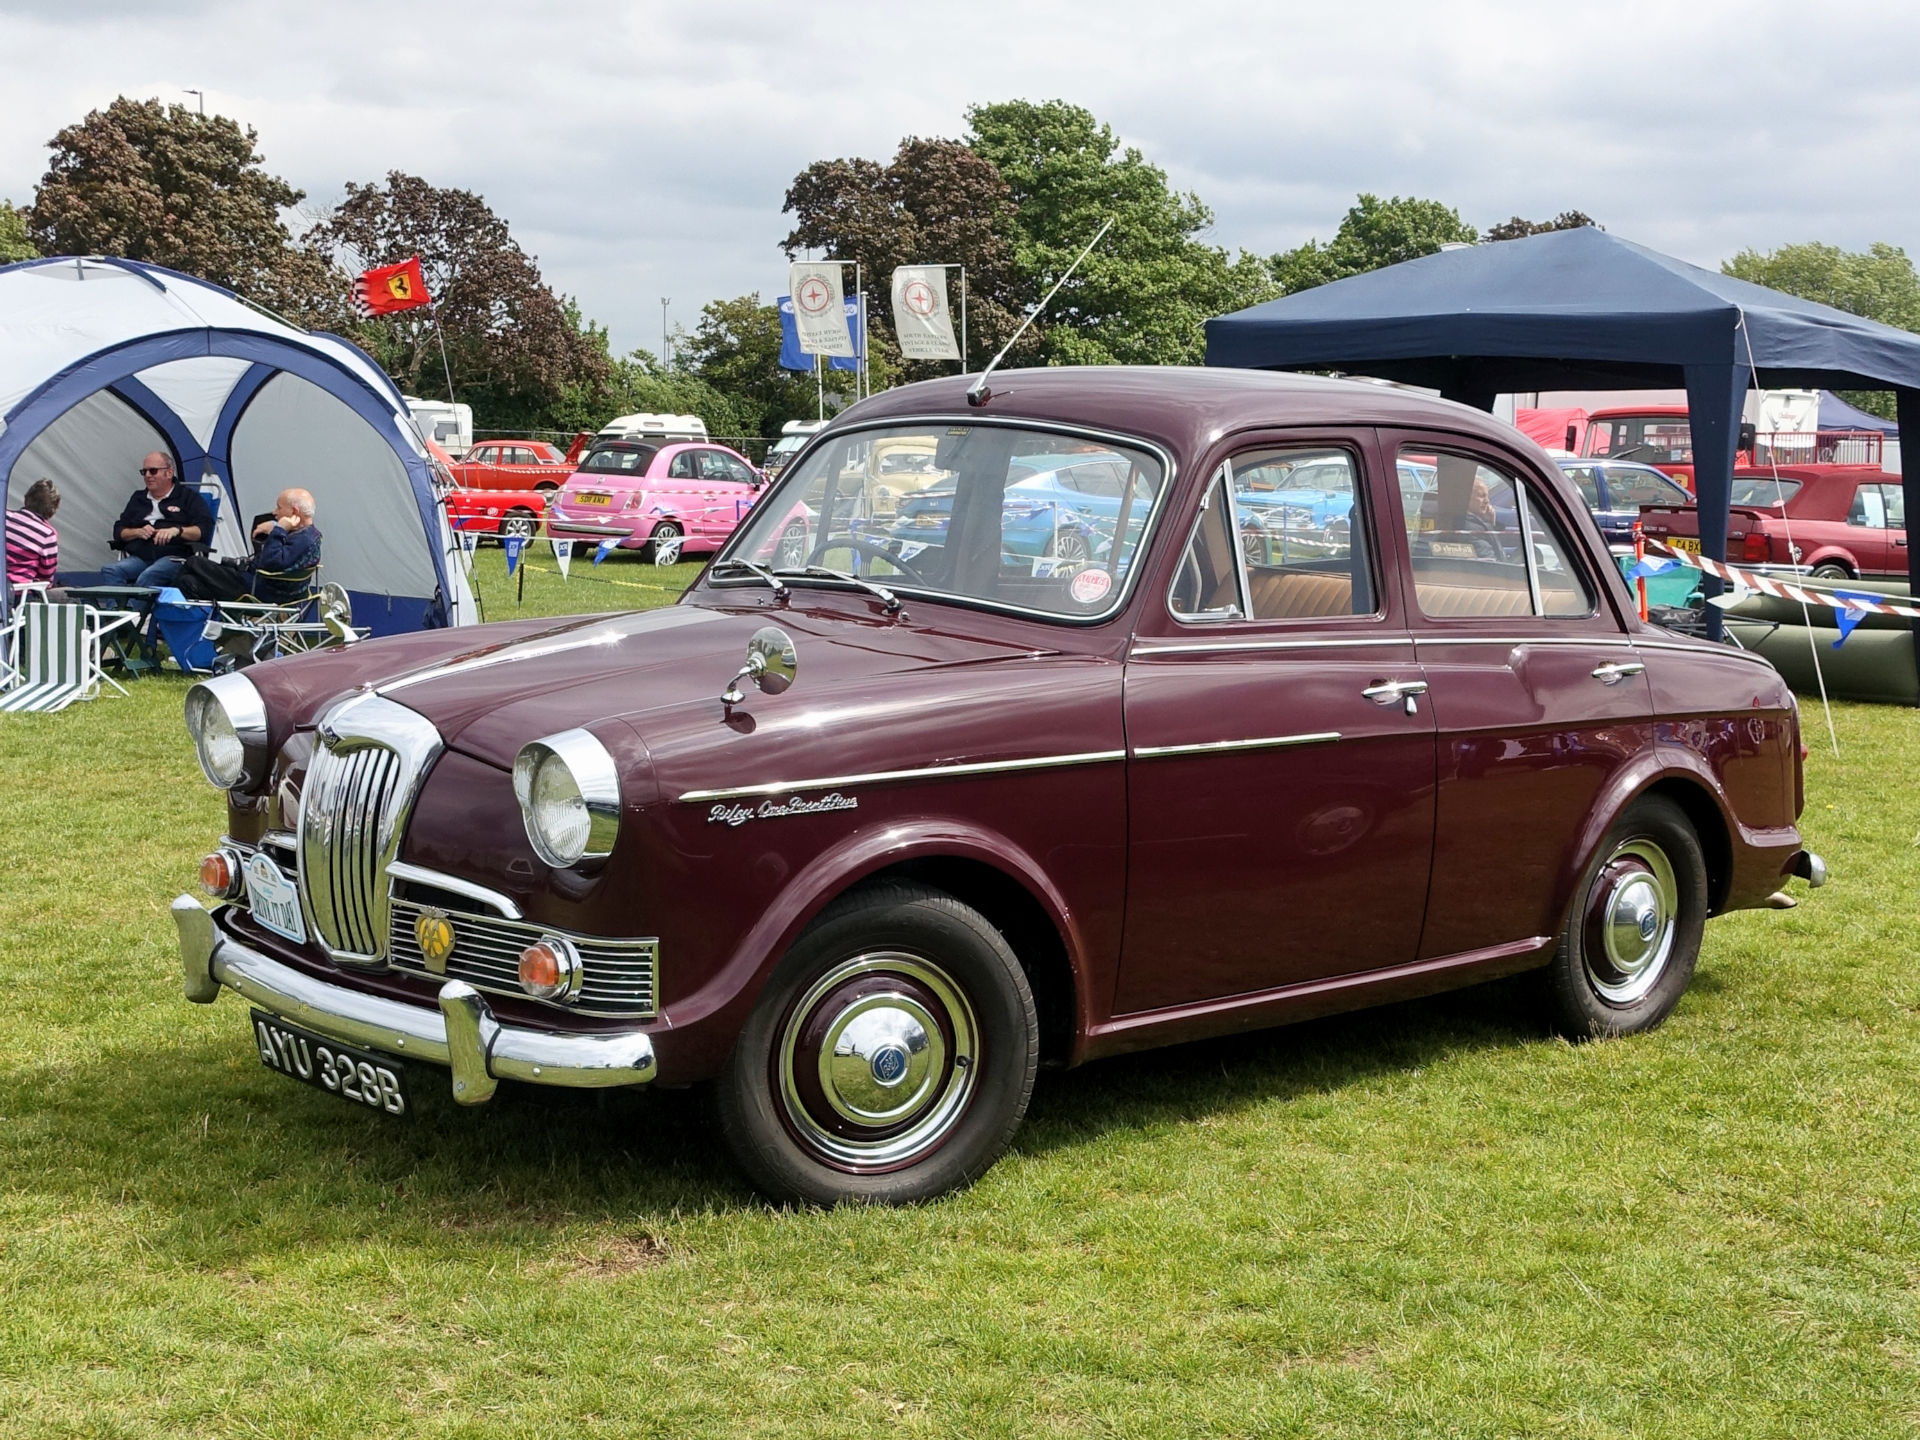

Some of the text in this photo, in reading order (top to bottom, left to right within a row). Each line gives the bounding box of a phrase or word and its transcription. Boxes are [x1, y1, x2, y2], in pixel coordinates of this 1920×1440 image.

[708, 804, 754, 826] Riley
[258, 1021, 405, 1115] AYU 328B
